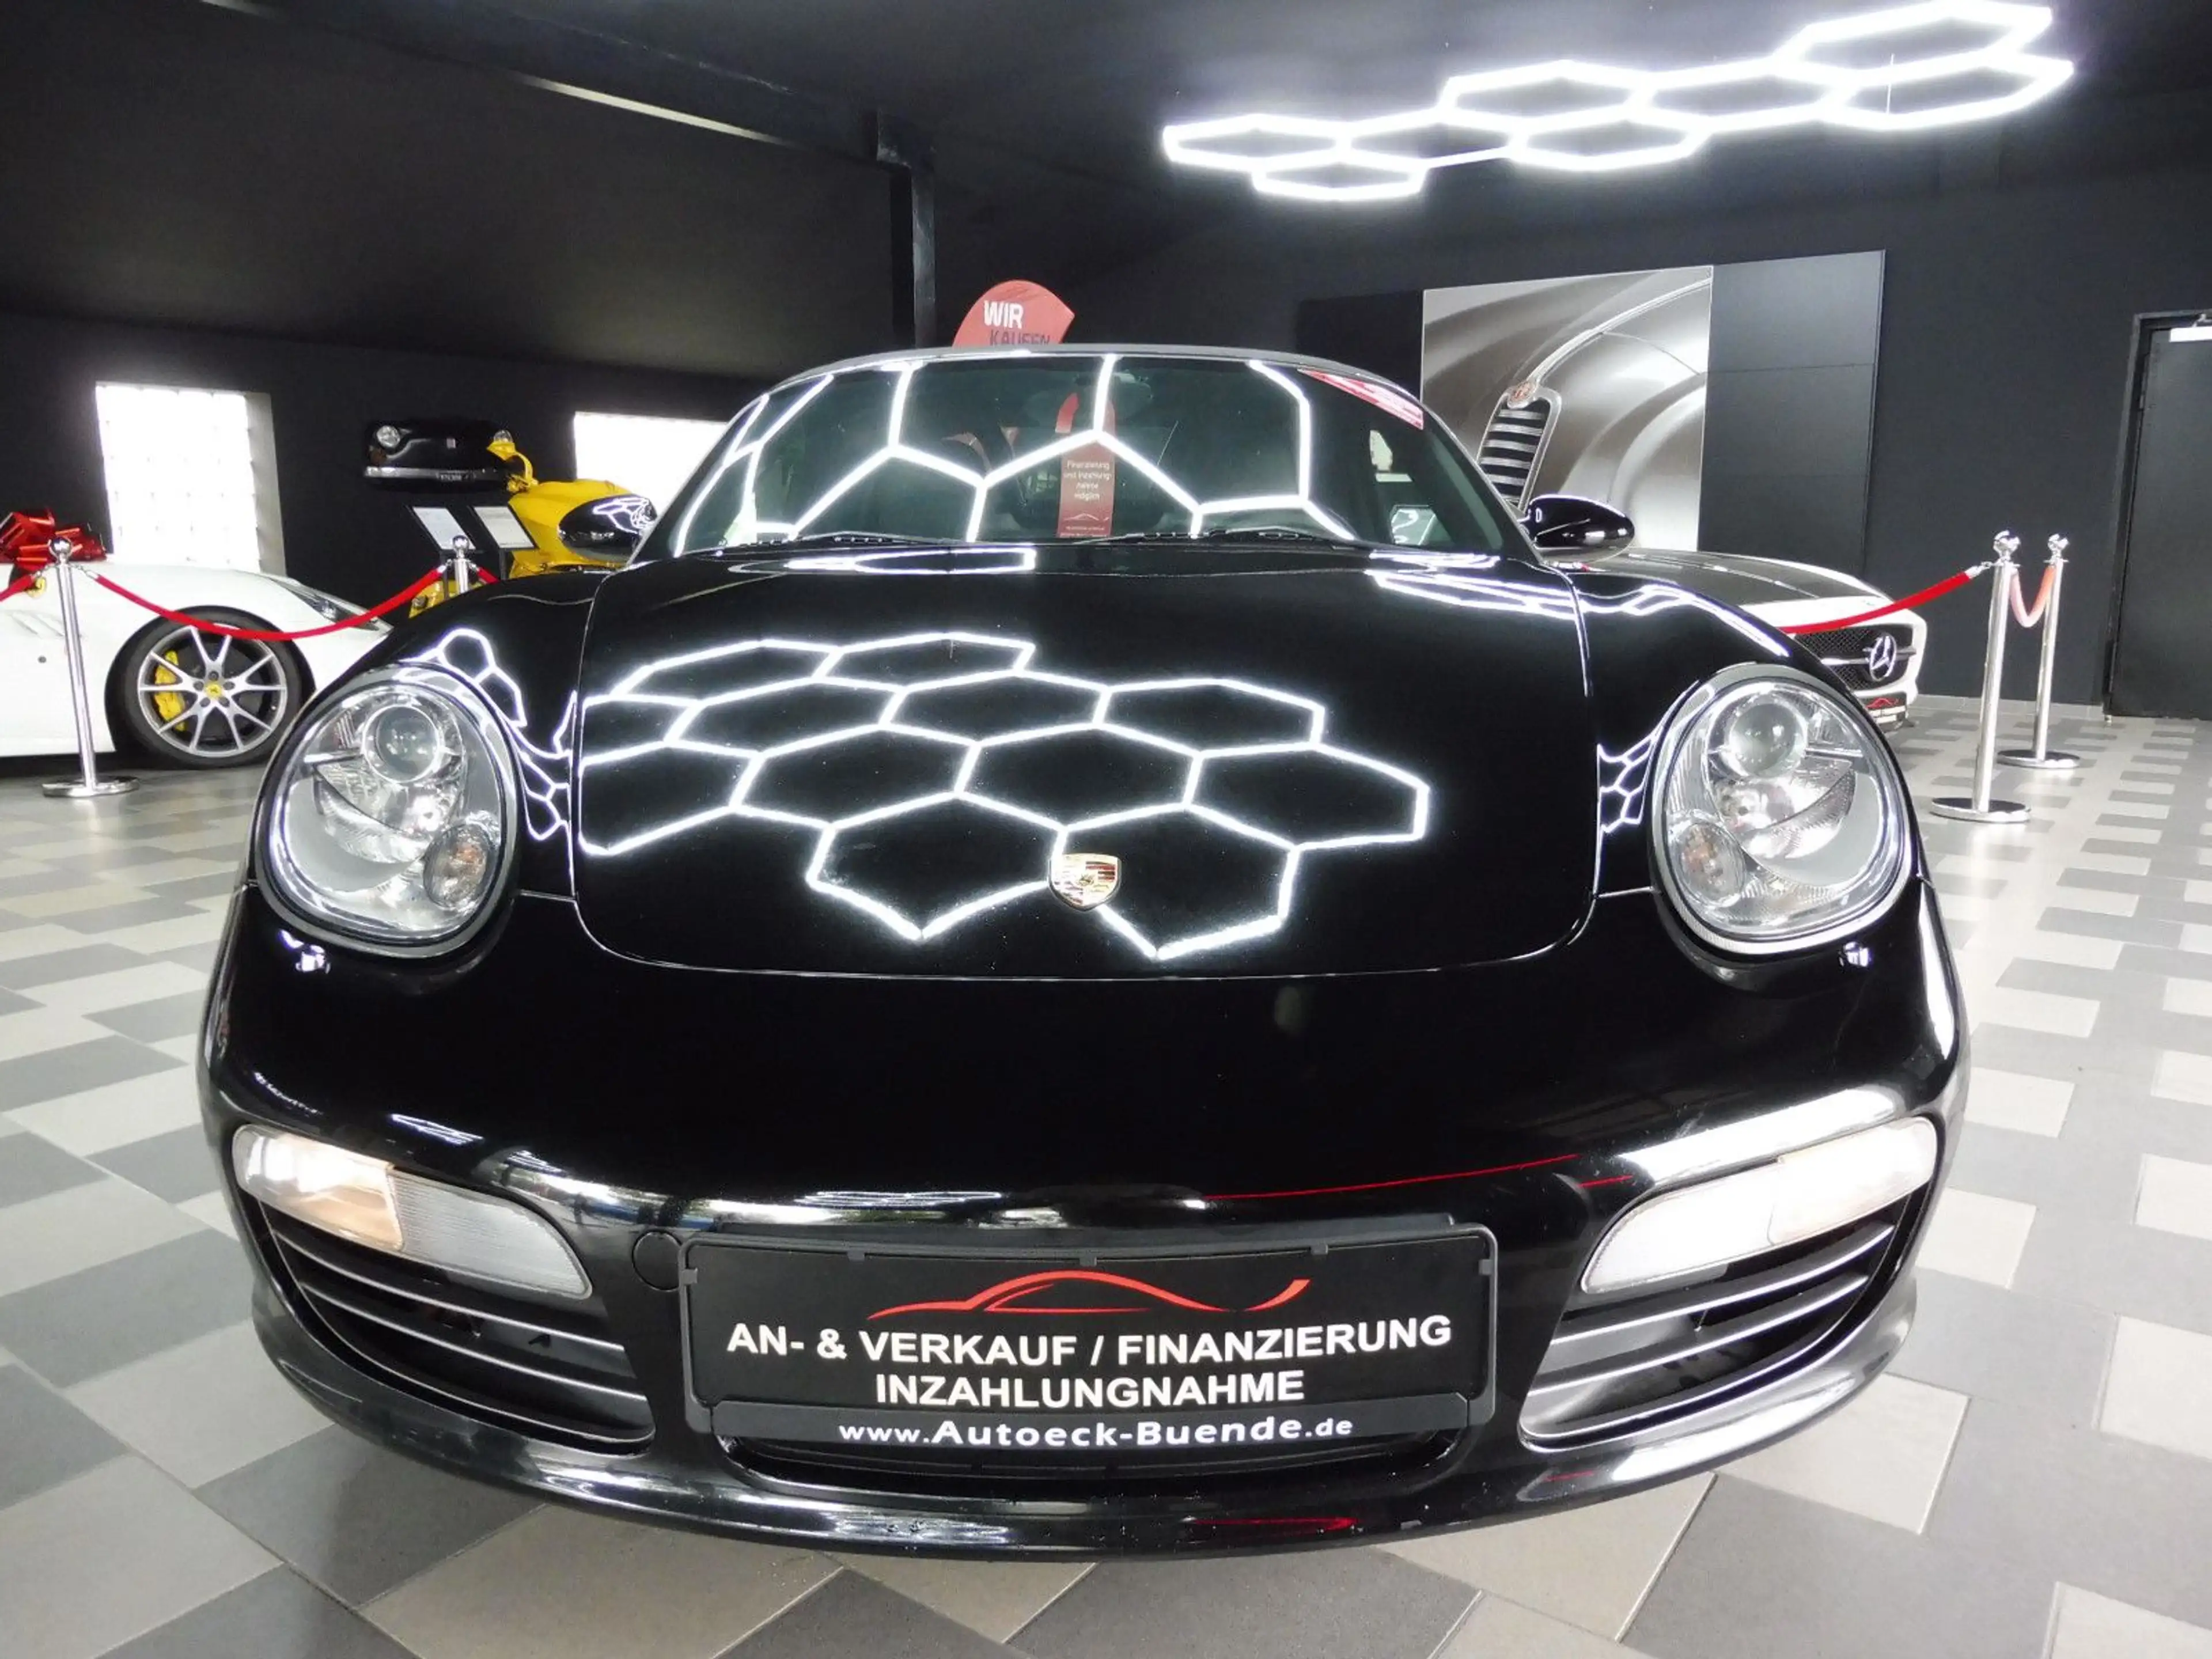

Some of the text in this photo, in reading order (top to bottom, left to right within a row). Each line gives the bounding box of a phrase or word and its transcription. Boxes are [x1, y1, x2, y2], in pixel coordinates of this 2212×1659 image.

[984, 300, 1024, 329] WIR
[726, 1315, 1451, 1366] AN- & VERKAUF / FINANZIERUNG
[876, 1370, 1304, 1408] INZAHLUNGNAHME
[838, 1416, 1353, 1448] www.Autoeck-Buende.de
